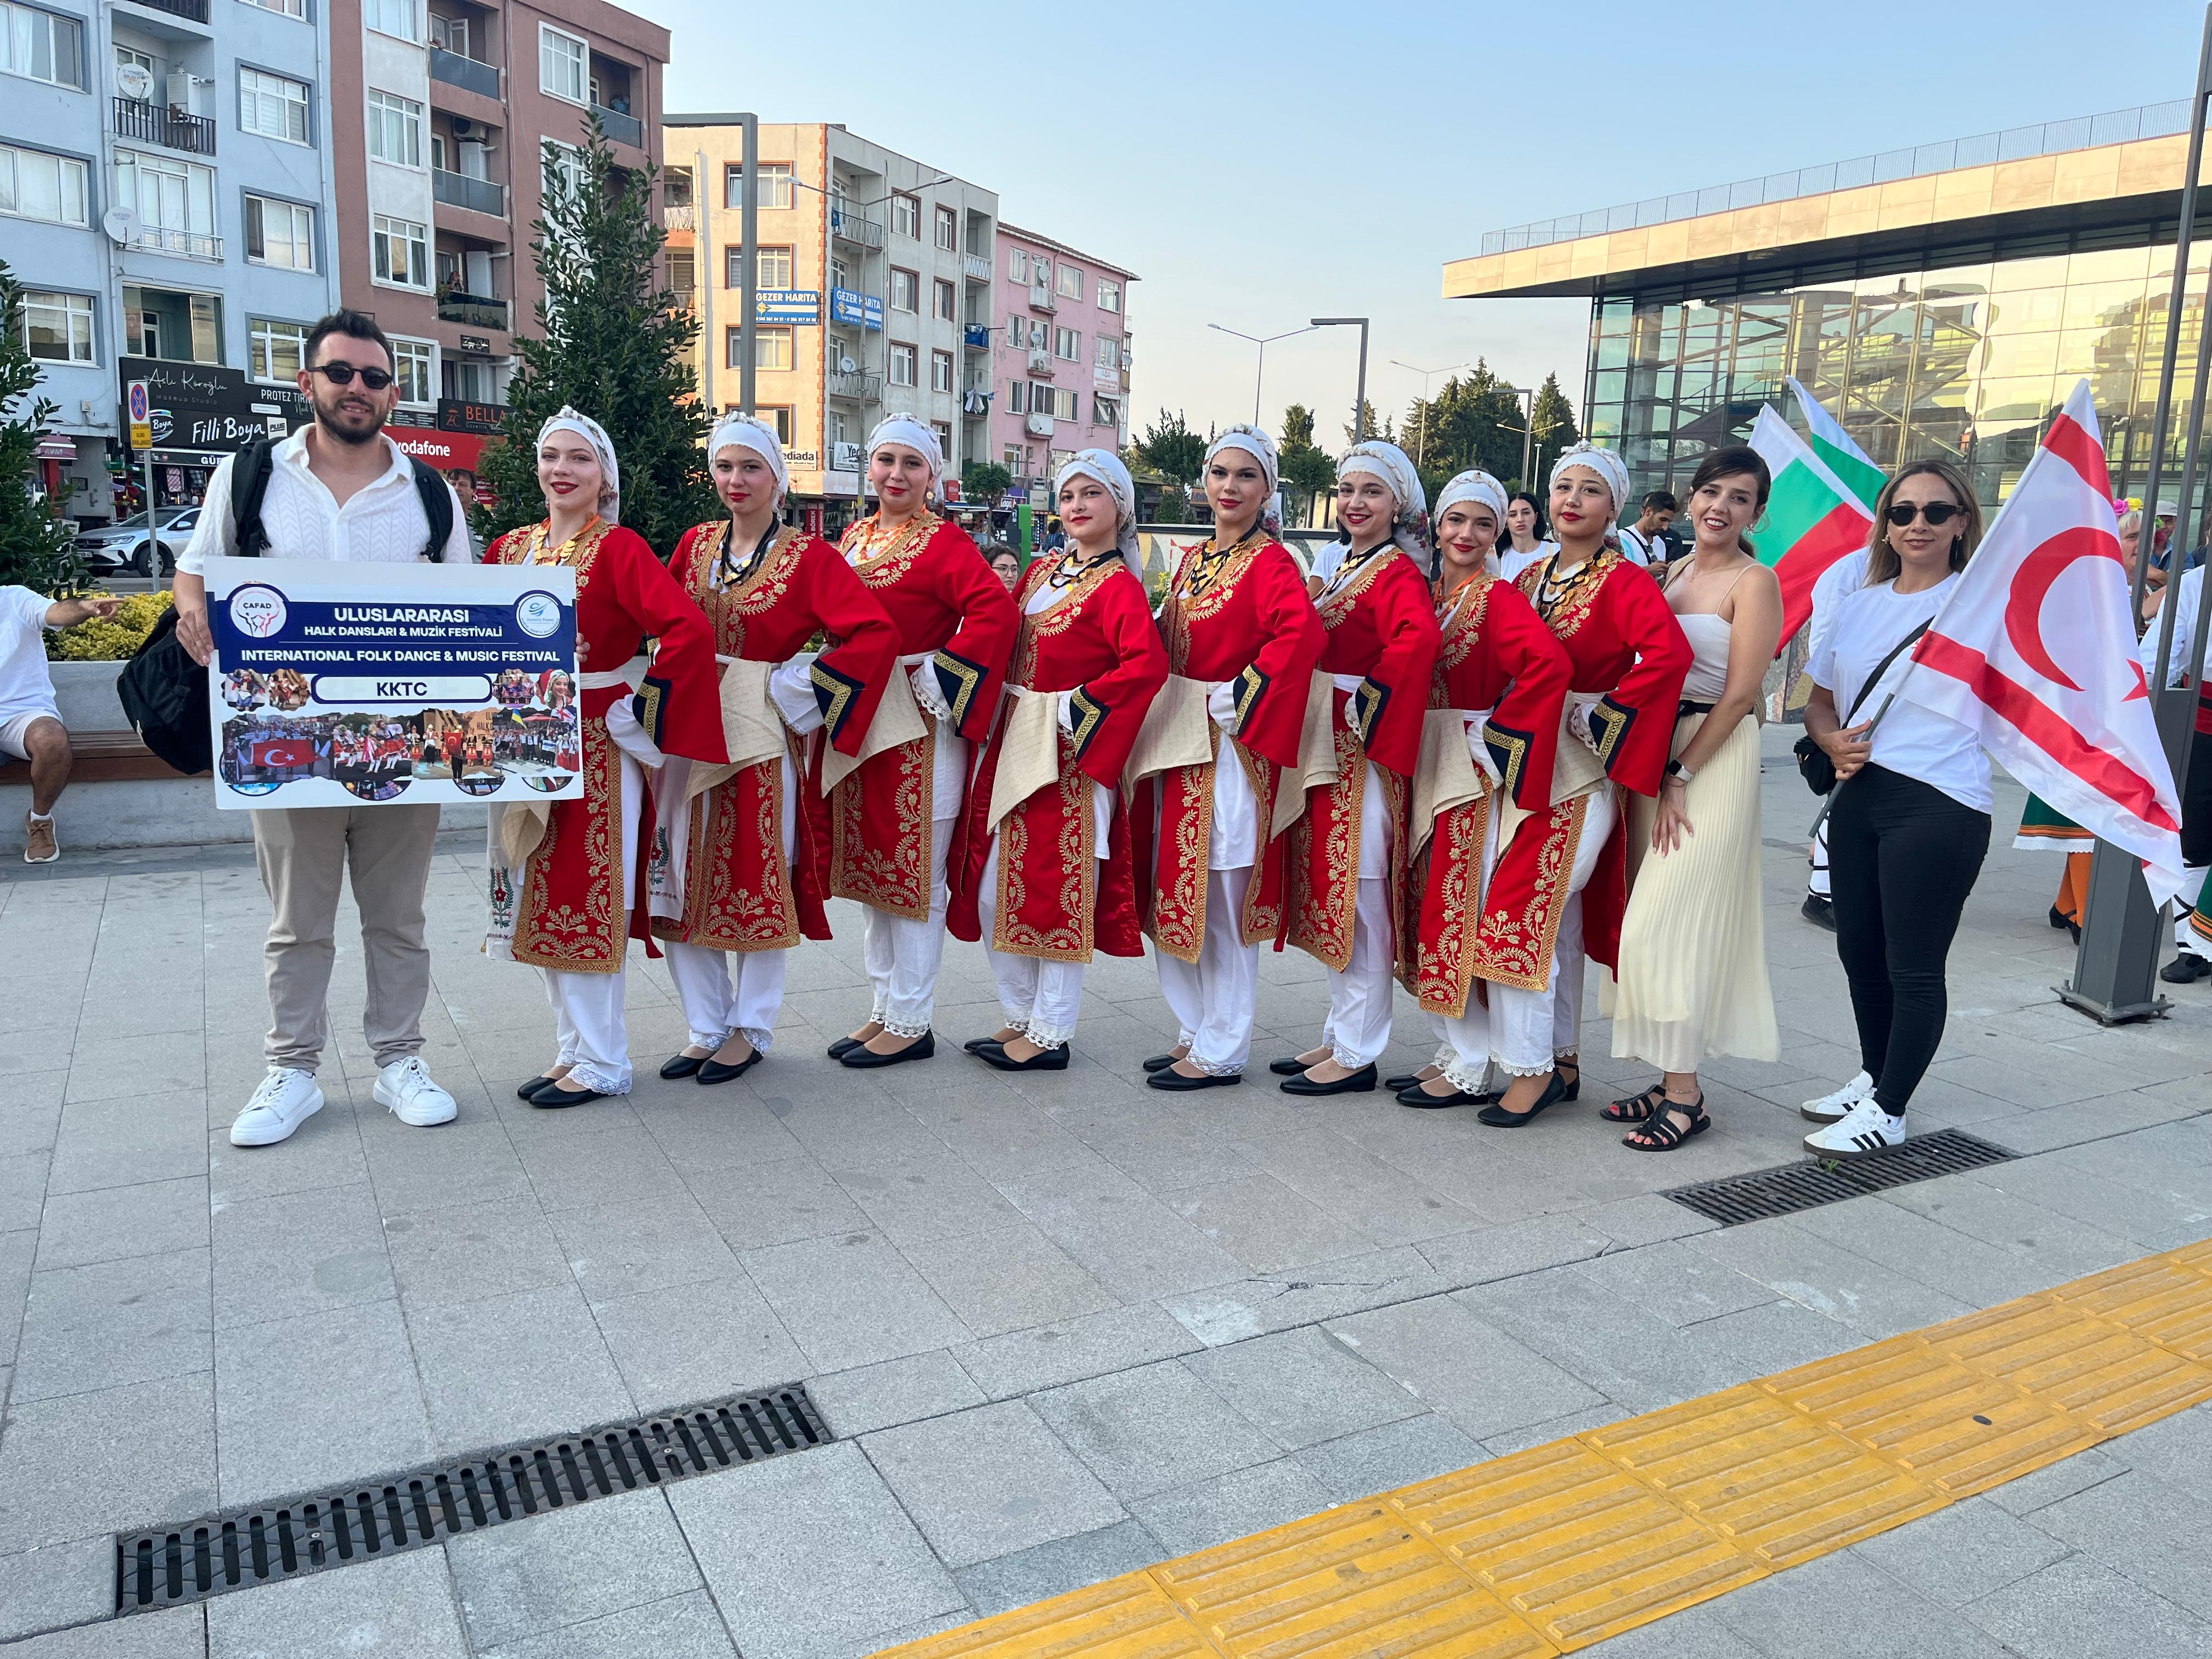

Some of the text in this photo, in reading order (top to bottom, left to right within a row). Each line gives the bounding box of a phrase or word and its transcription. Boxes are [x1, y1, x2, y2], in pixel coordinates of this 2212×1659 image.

[755, 292, 783, 302] GEZER
[837, 290, 857, 304] GEZER
[261, 388, 291, 402] PROTEZ
[153, 419, 173, 432] Boya
[192, 417, 266, 444] Filli Boya
[397, 439, 450, 457] vodafone
[334, 607, 470, 623] ULUSLARARASI
[304, 625, 503, 637] HALK DANSLARI & MUZİK FESTİVALİ
[241, 650, 560, 662] INTERNATIONAL FOLK DANCE & MUSIC FESTIVAL
[376, 682, 427, 696] KKTC
